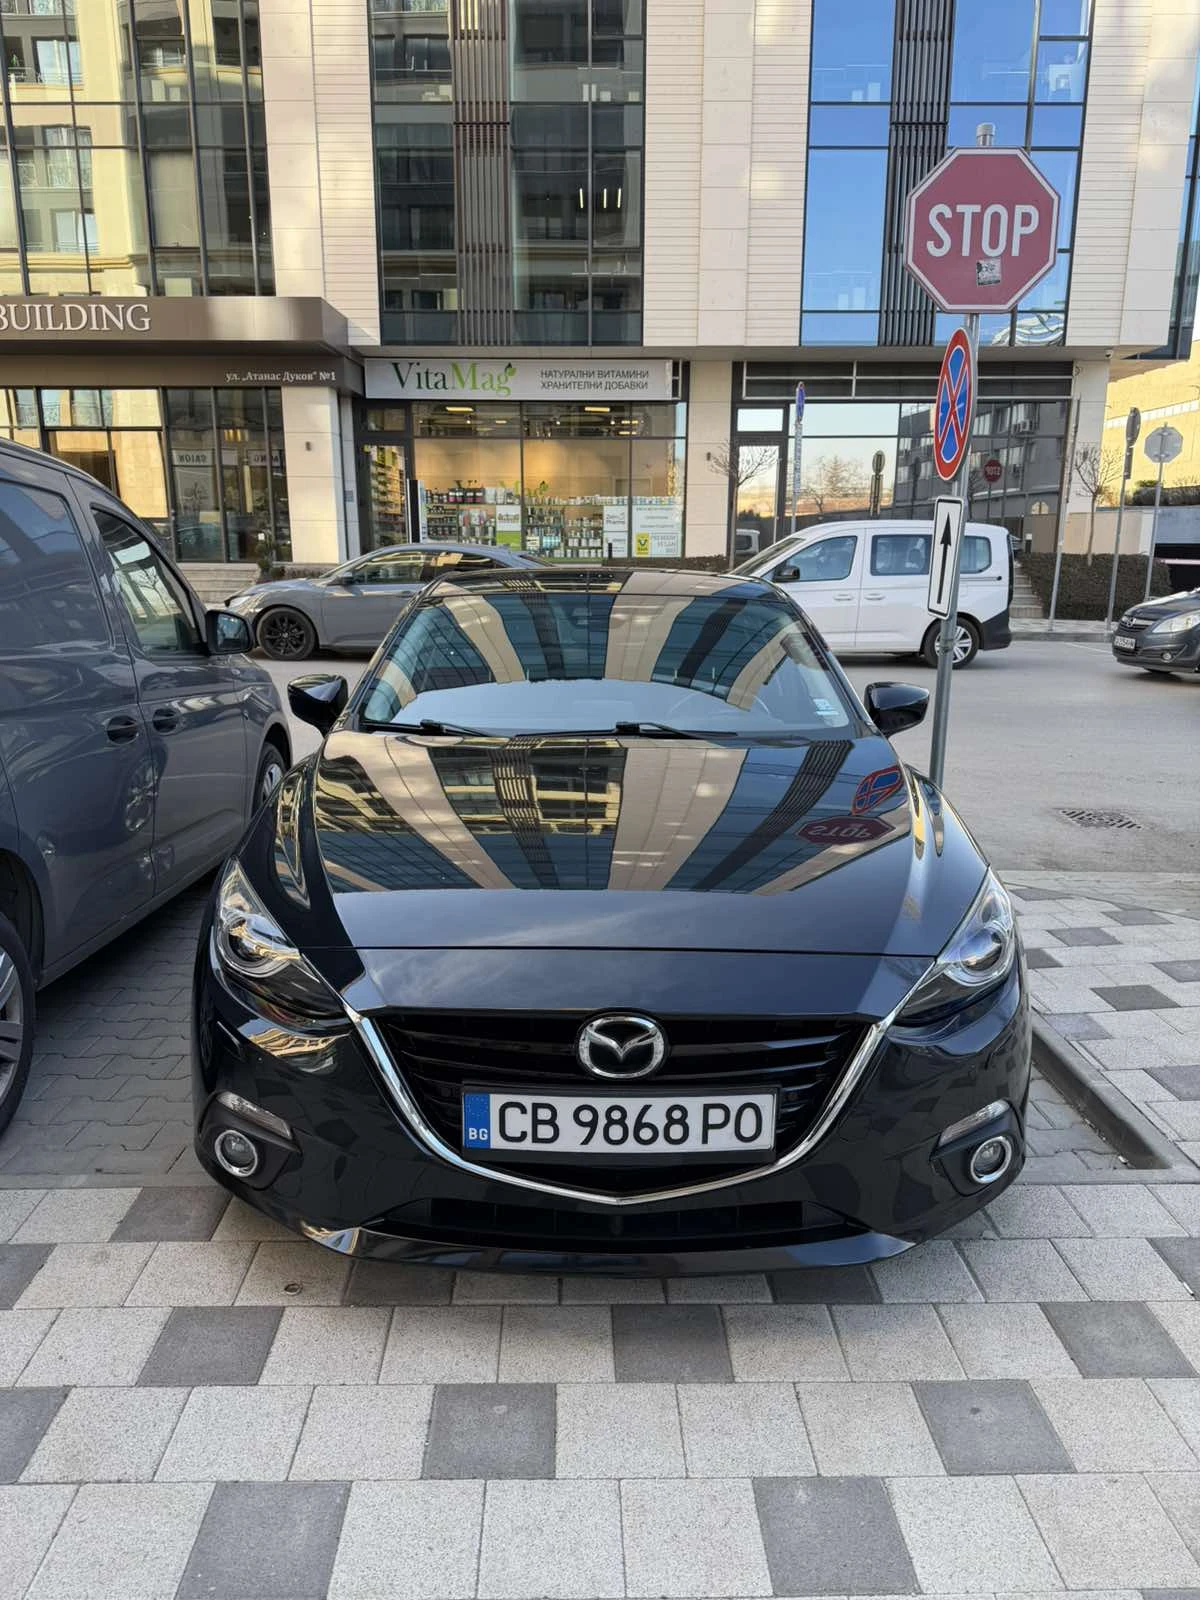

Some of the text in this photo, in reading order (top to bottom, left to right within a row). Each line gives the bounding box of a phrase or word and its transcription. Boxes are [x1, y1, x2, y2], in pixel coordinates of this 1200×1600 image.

[926, 203, 1040, 257] STOP
[0, 303, 151, 332] BUILDING
[319, 371, 336, 381] №1
[392, 361, 512, 397] VitaMag
[541, 369, 649, 378] НАТУРАЛНИ ВИТАМИНИ
[541, 381, 648, 391] ХРАНИТЕЛНИ ДОБАВКИ
[468, 1127, 488, 1140] BG
[499, 1101, 762, 1146] CB 9868 PO
